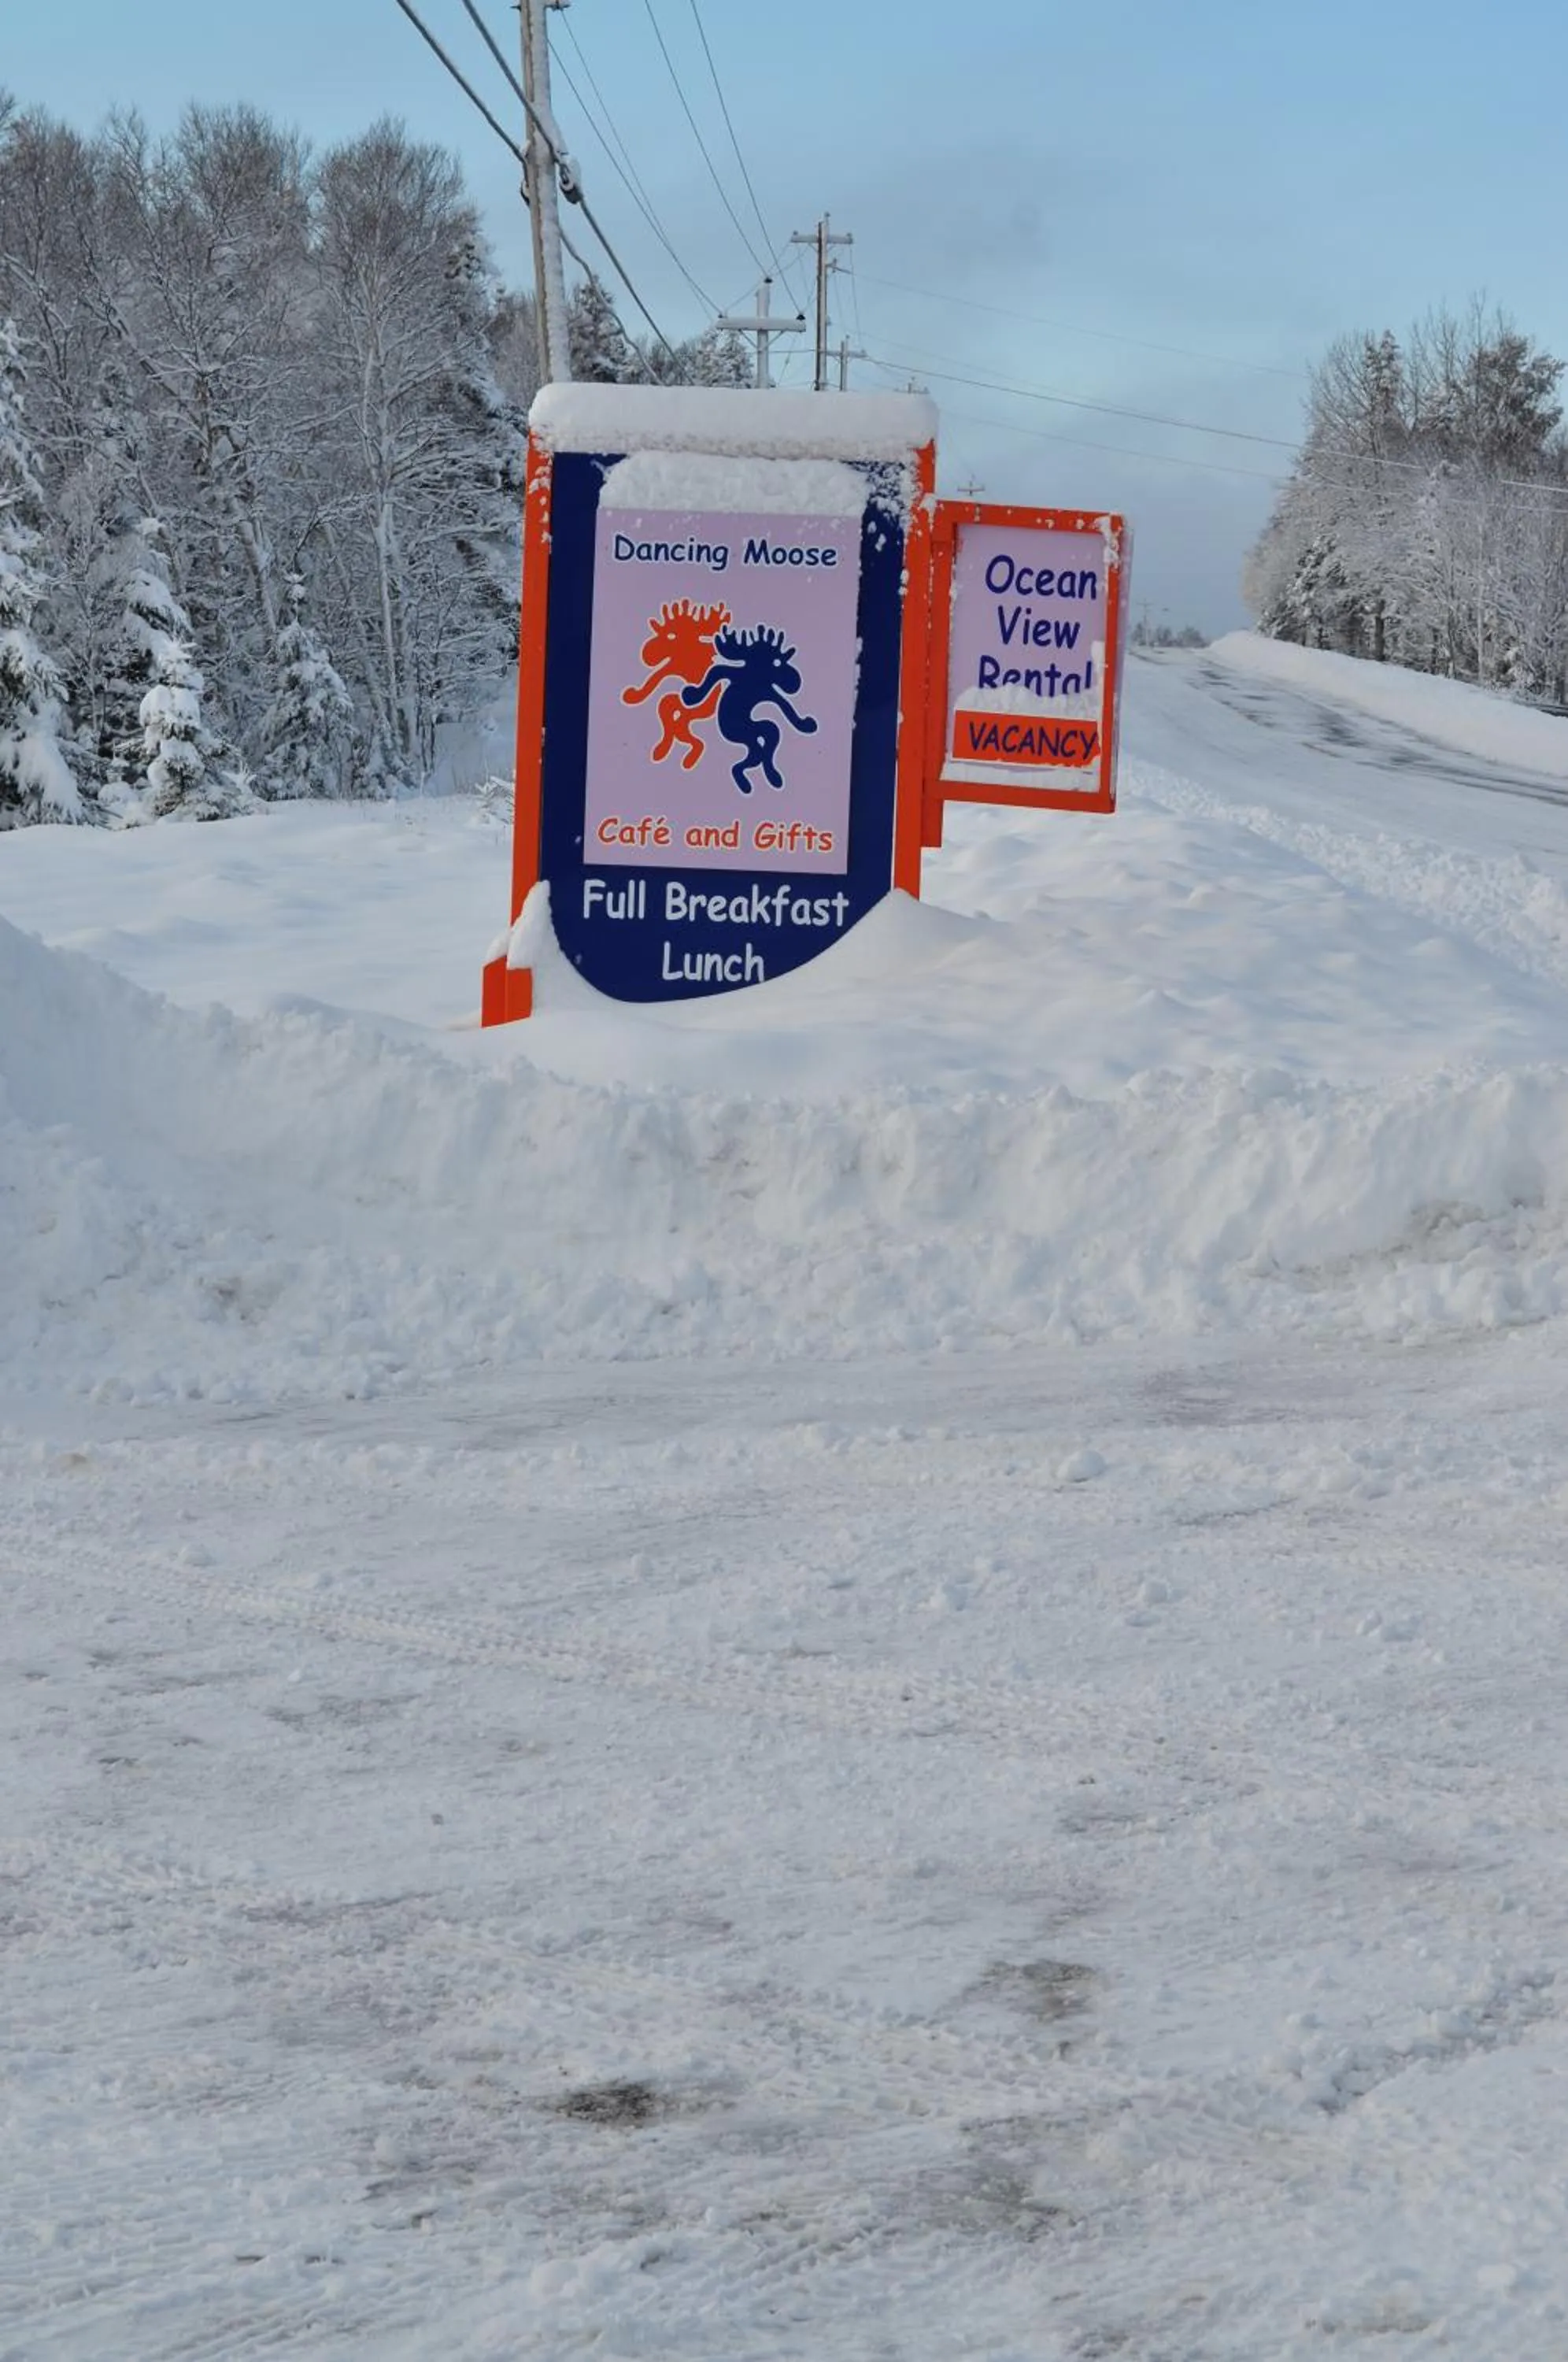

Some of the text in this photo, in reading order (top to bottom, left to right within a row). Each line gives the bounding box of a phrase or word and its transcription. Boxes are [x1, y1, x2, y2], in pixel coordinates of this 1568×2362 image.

[614, 535, 837, 571] Dancing Moose
[986, 554, 1096, 600] Ocean
[997, 605, 1080, 650] View
[969, 721, 1098, 761] VACANCY
[597, 817, 834, 851] Café and Gifts
[583, 879, 849, 927] Full Breakfast
[662, 941, 765, 983] Lunch
